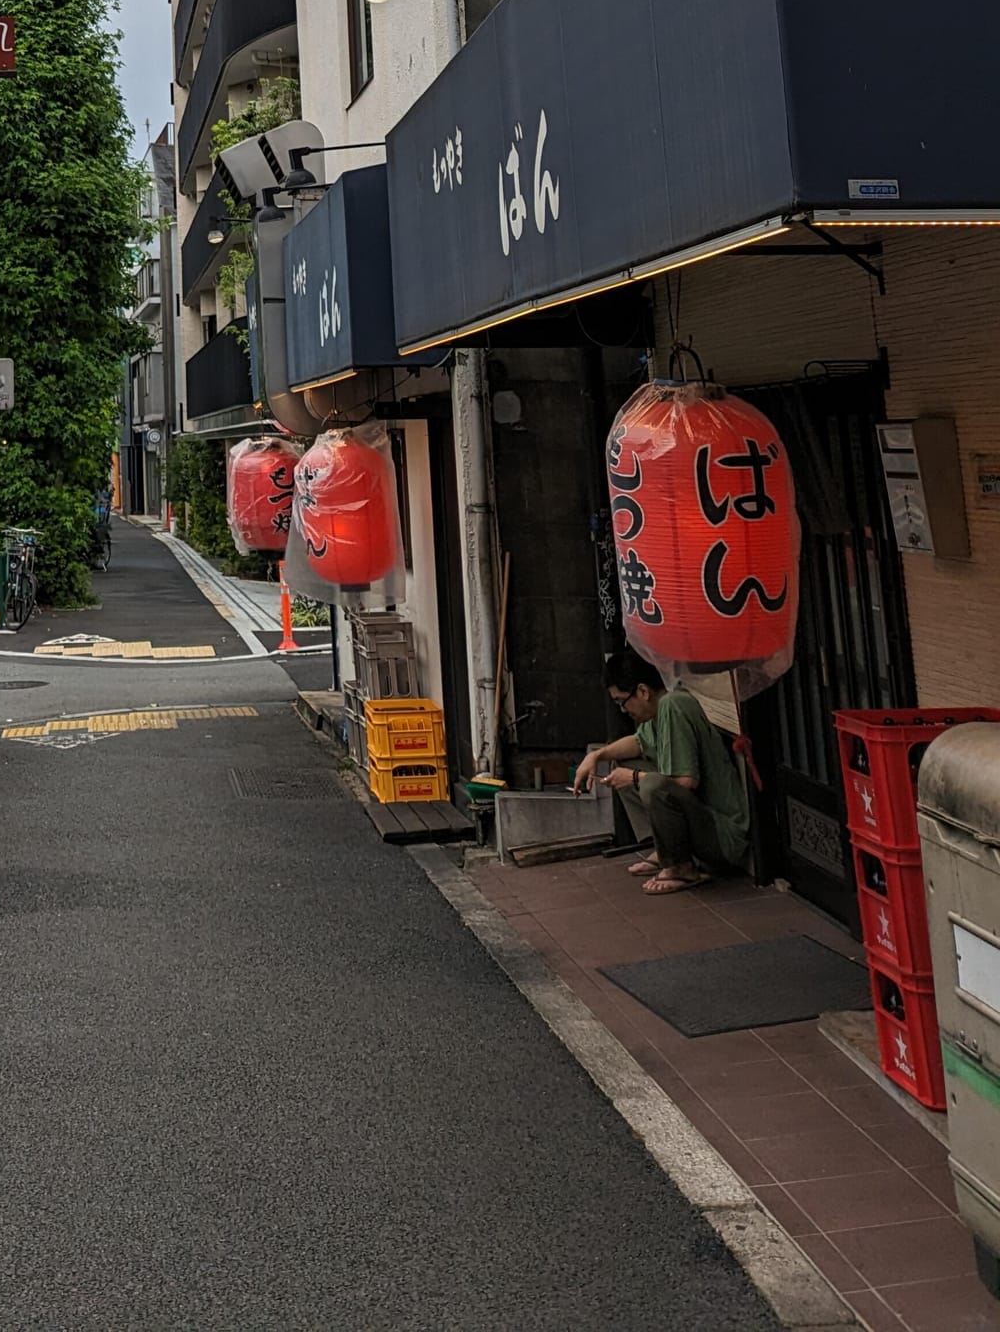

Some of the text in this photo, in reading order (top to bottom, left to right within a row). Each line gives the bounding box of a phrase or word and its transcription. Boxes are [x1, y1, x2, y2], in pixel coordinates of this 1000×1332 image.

[497, 108, 561, 257] ばん
[319, 265, 341, 348] ばん
[694, 437, 788, 618] ばん
